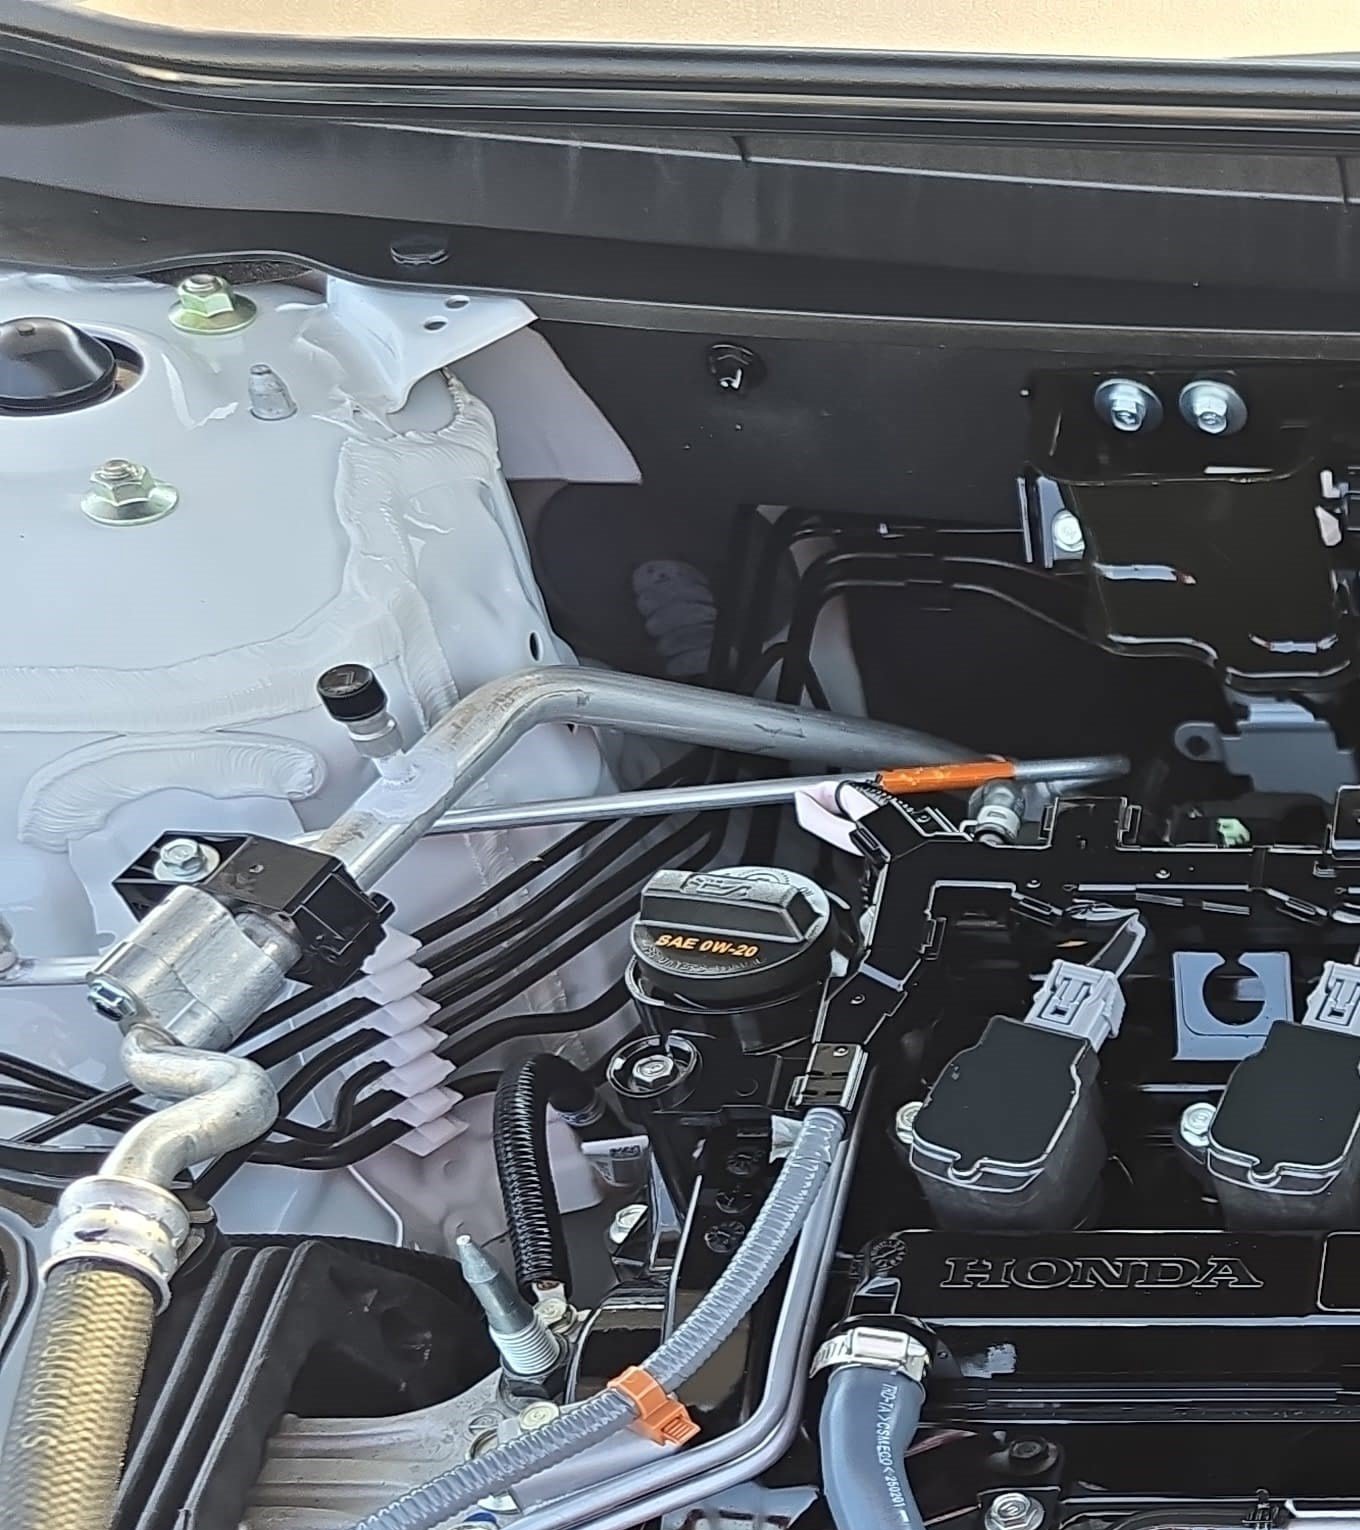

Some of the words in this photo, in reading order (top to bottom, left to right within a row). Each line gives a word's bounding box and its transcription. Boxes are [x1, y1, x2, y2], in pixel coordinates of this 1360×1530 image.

[655, 934, 699, 950] SAE
[698, 940, 759, 958] 0W-20
[940, 1256, 1264, 1290] HONDA
